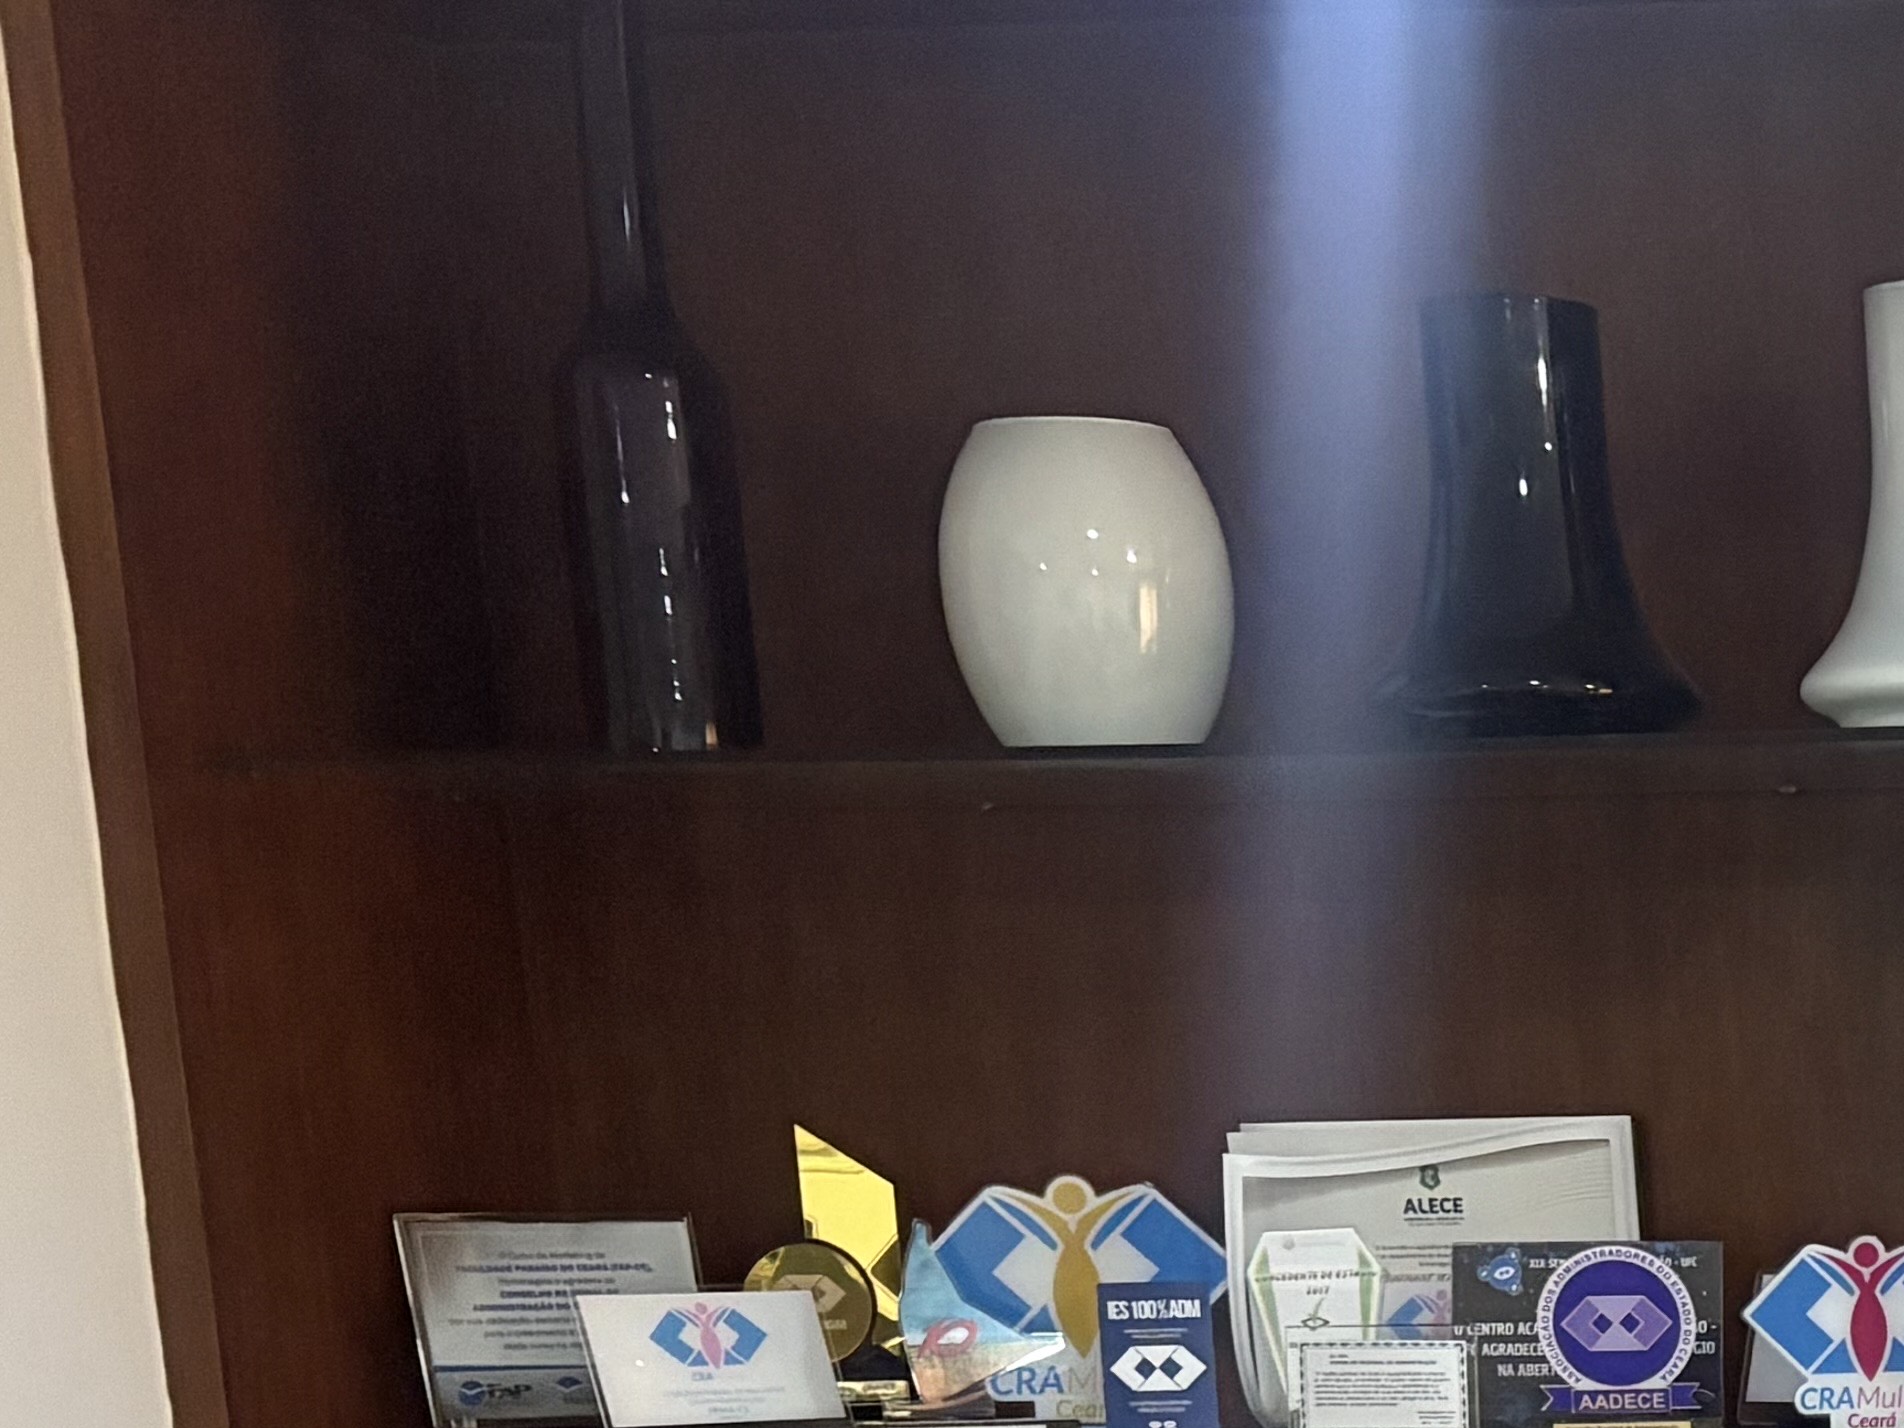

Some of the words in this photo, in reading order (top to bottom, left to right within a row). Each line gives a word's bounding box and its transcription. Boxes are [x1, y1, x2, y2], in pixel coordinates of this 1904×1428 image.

[1403, 1197, 1464, 1214] ALECE
[1553, 1248, 1656, 1287] ADMINISTRADORES
[1656, 1264, 1673, 1281] DO
[1543, 1288, 1557, 1309] DOS
[1670, 1281, 1694, 1326] ESTADO
[1106, 1300, 1128, 1320] IES
[1466, 1321, 1515, 1336] CENTRO
[1682, 1329, 1693, 1346] DO
[1542, 1314, 1583, 1385] ASSOCIAÇÃO
[1497, 1363, 1515, 1377] NA
[1578, 1392, 1667, 1411] AADECE
[1847, 1412, 1896, 1428] Ceará
